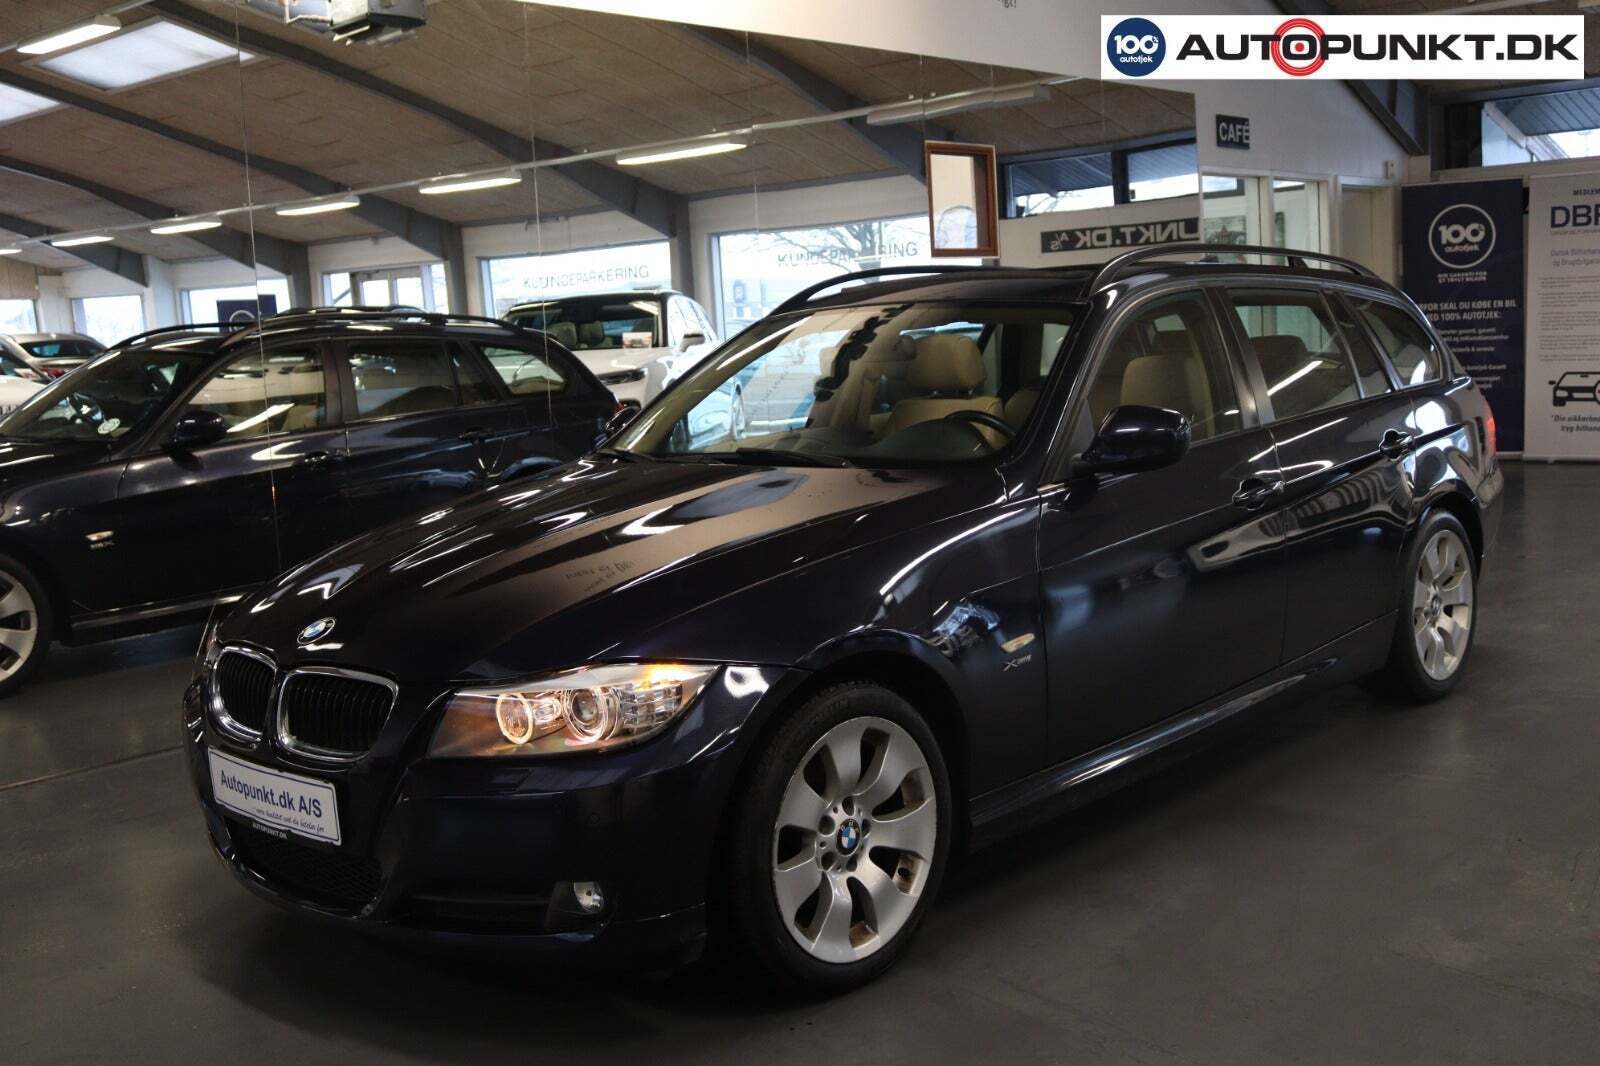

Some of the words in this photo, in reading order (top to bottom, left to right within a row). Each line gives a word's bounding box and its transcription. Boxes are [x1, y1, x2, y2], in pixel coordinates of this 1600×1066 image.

[1219, 121, 1250, 143] CAFÉ
[1440, 302, 1457, 311] SKAL
[1459, 301, 1470, 310] DU
[1471, 301, 1492, 309] KØBE
[1493, 300, 1503, 308] EN
[1505, 299, 1516, 308] BIL
[221, 770, 296, 811] Autopunkt.dk
[298, 795, 322, 818] A/S
